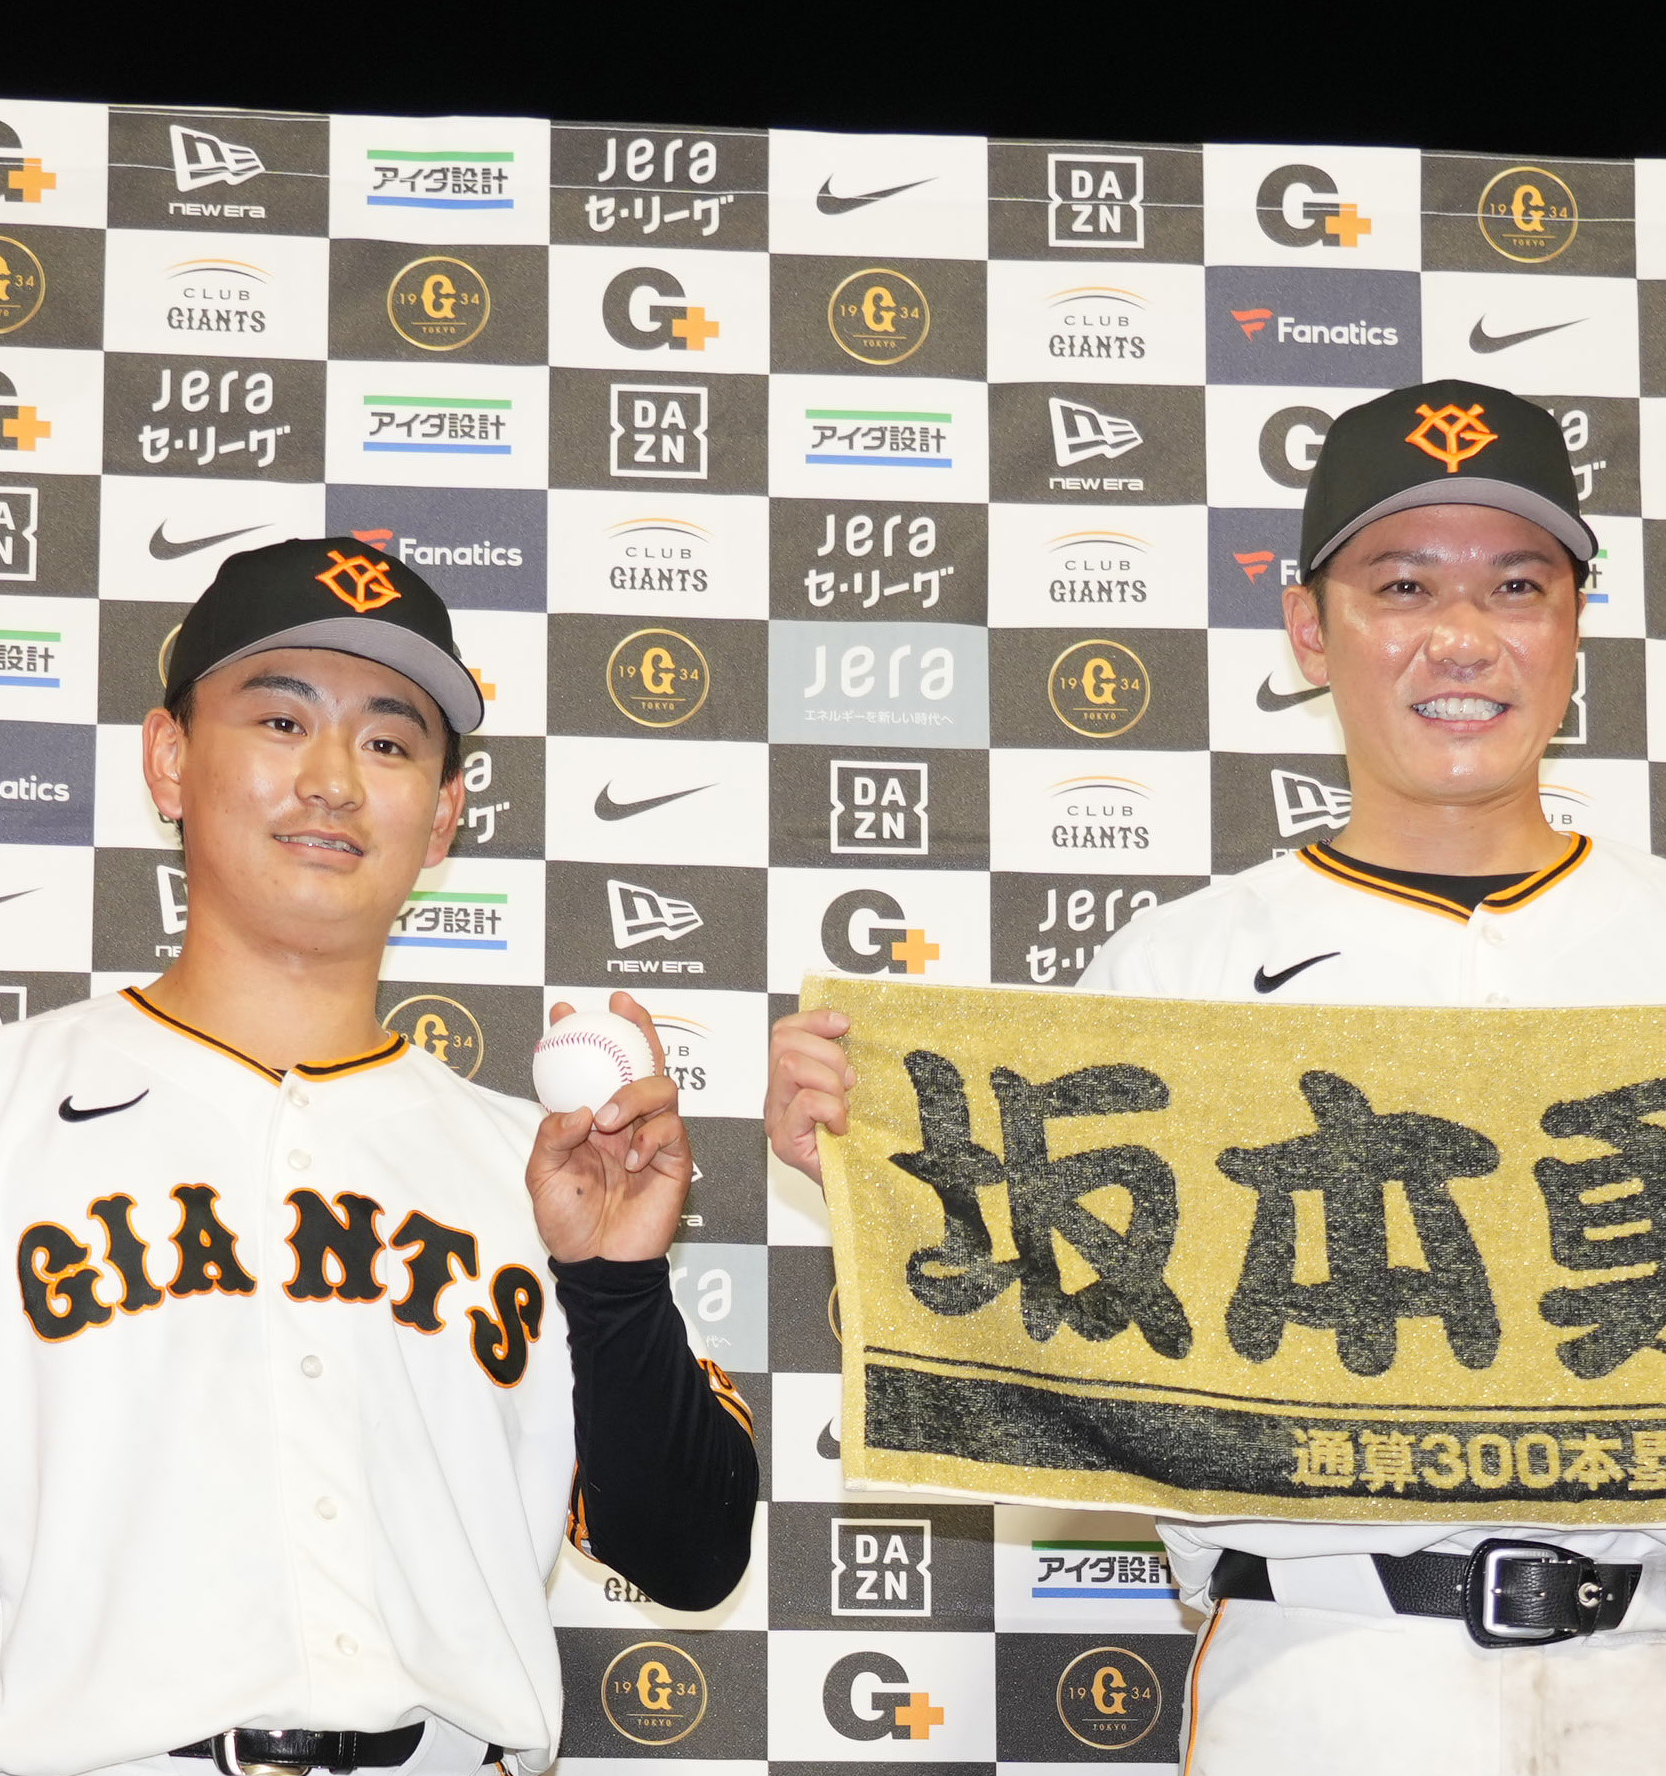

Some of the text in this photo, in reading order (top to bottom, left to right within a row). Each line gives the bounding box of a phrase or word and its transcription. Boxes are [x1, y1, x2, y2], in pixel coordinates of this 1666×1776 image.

[372, 166, 508, 194] アイダ設計
[182, 287, 250, 301] CLUB
[166, 306, 265, 333] GIANTS
[1063, 314, 1129, 327] CLUB
[1277, 315, 1398, 346] Fanatics
[1048, 334, 1145, 359] GIANTS
[368, 411, 506, 440] アイダ設計
[811, 424, 946, 453] アイダ設計
[624, 546, 691, 559] CLUB
[1065, 559, 1134, 572] CLUB
[609, 565, 708, 592] GIANTS
[1048, 579, 1147, 603] GIANTS
[1066, 805, 1133, 817] CLUB
[1051, 824, 1149, 849] GIANTS
[17, 1183, 545, 1388] GIANTS
